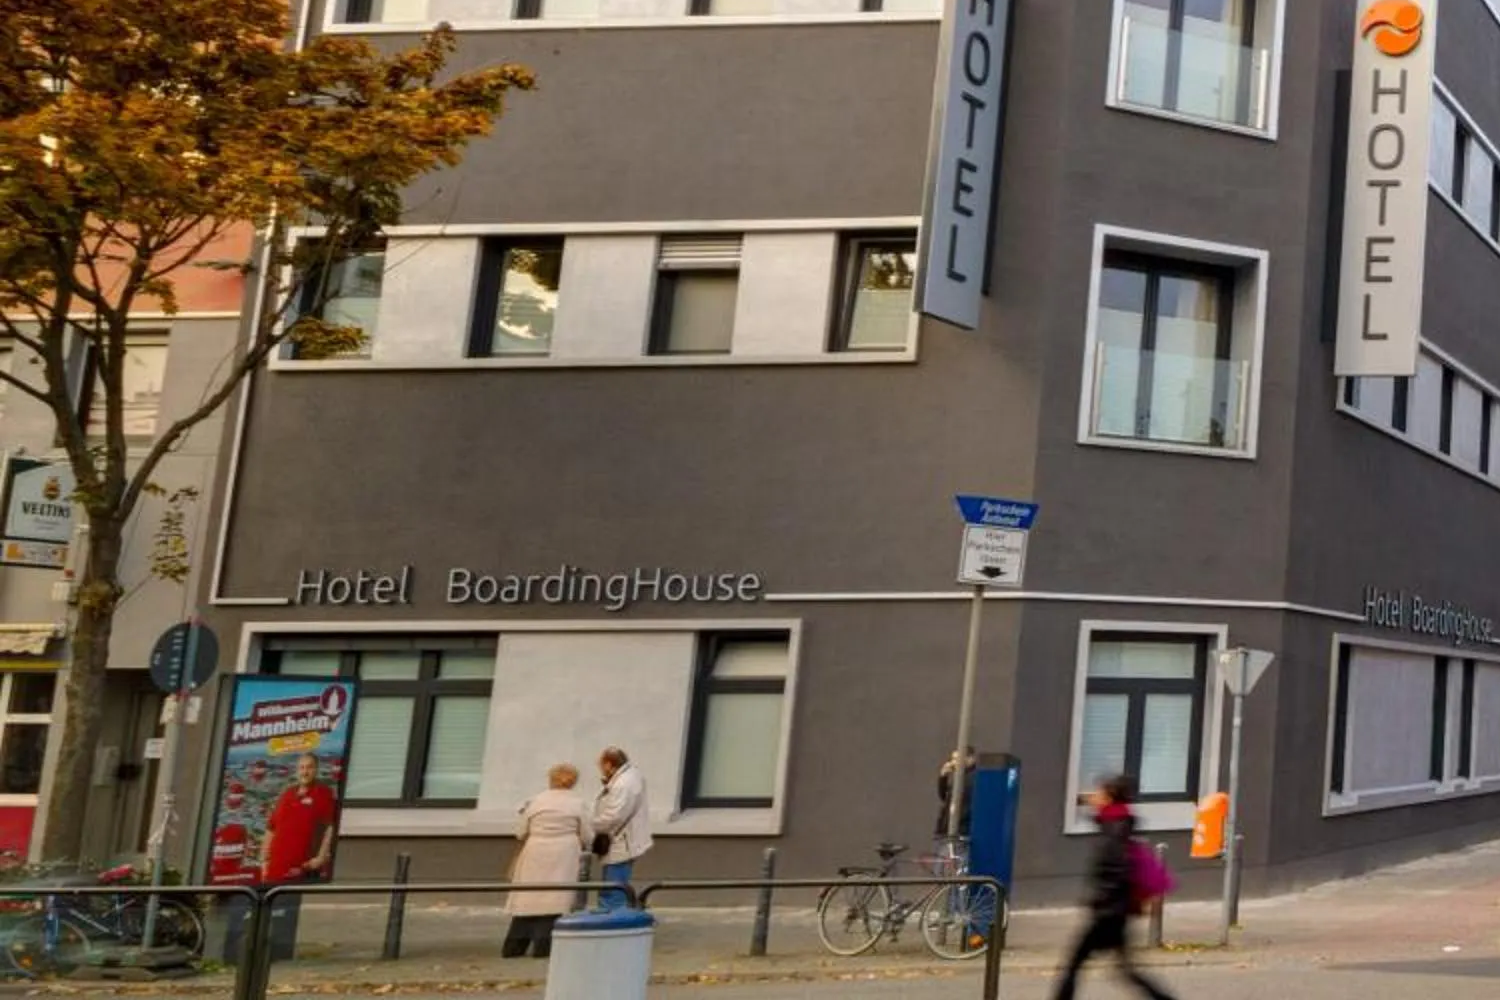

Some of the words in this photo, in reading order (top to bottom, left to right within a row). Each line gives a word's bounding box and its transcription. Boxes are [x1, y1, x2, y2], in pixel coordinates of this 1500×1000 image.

[1361, 69, 1408, 341] HOTEL
[296, 565, 413, 604] Hotel
[447, 563, 761, 611] BoardingHouse
[1364, 584, 1404, 627] Hotel
[232, 712, 330, 741] Mannheim
